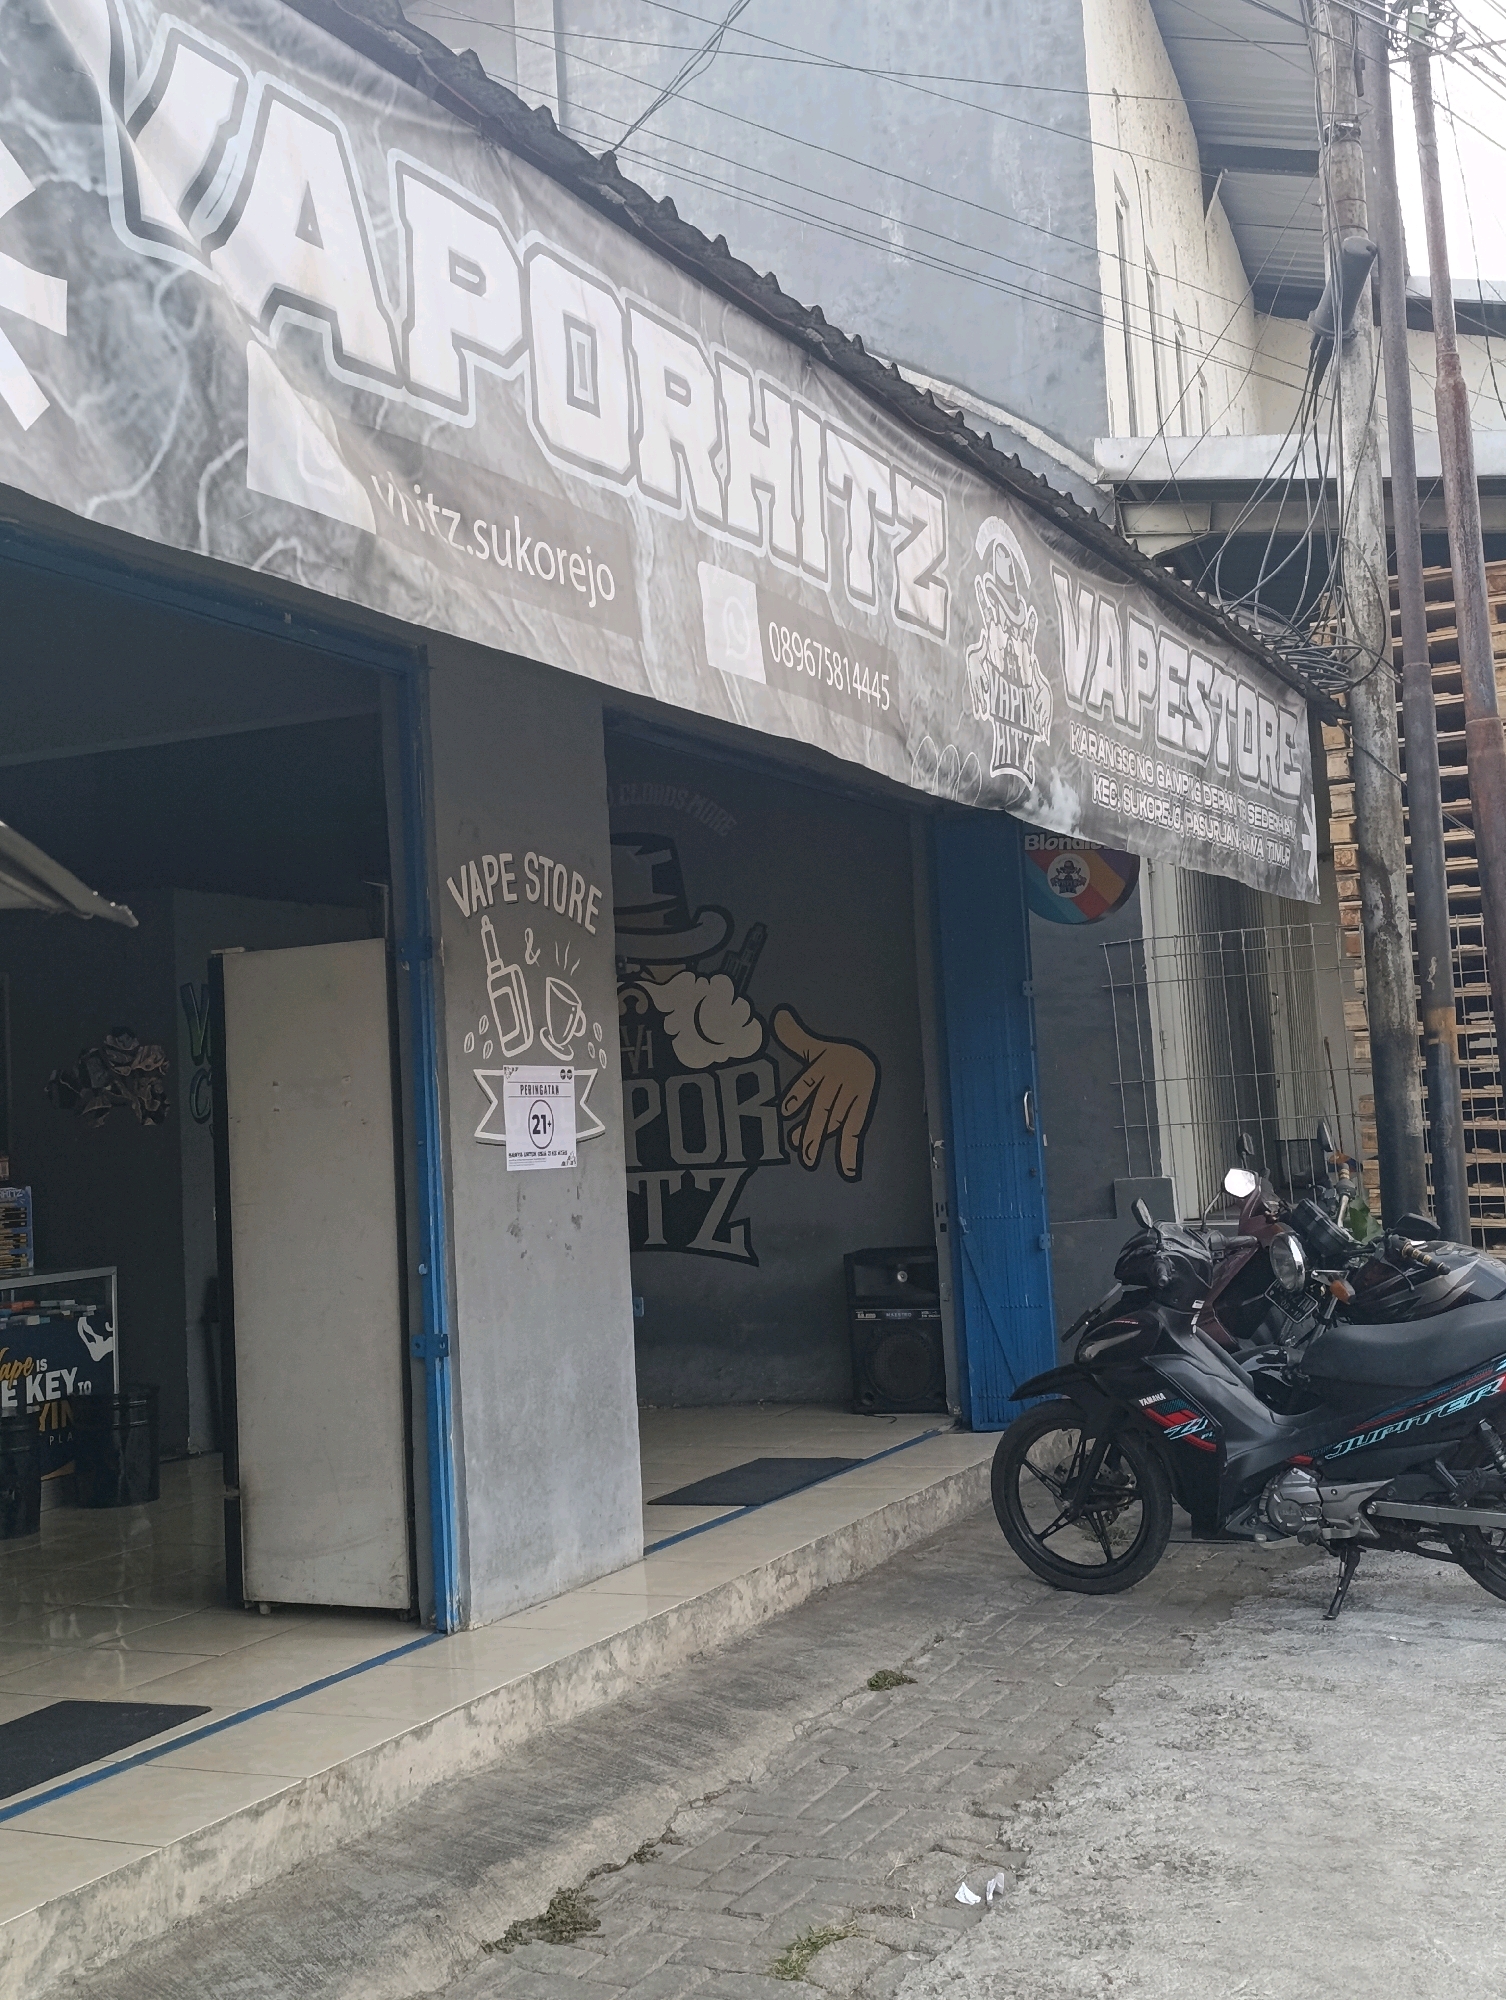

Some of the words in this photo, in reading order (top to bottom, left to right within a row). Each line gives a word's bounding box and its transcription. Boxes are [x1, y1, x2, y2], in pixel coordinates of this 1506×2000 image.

[48, 0, 949, 643] VAPORHITZ
[769, 622, 890, 711] 089675814445
[1050, 561, 1301, 804] VAPESTORE
[995, 722, 1034, 780] HITZ
[1156, 760, 1204, 807] GAMPIG
[447, 853, 518, 918] VAPE
[523, 852, 602, 935] STORE
[524, 928, 541, 966] &
[520, 1084, 560, 1096] PERINGATAN
[623, 1058, 787, 1168] POR
[531, 1114, 552, 1135] 21+
[0, 1347, 34, 1390] ape
[36, 1358, 48, 1372] IS
[26, 1366, 78, 1405] KEY
[77, 1380, 92, 1396] TO
[1138, 1391, 1167, 1407] YAMAHA
[1325, 1375, 1506, 1460] JUPITER
